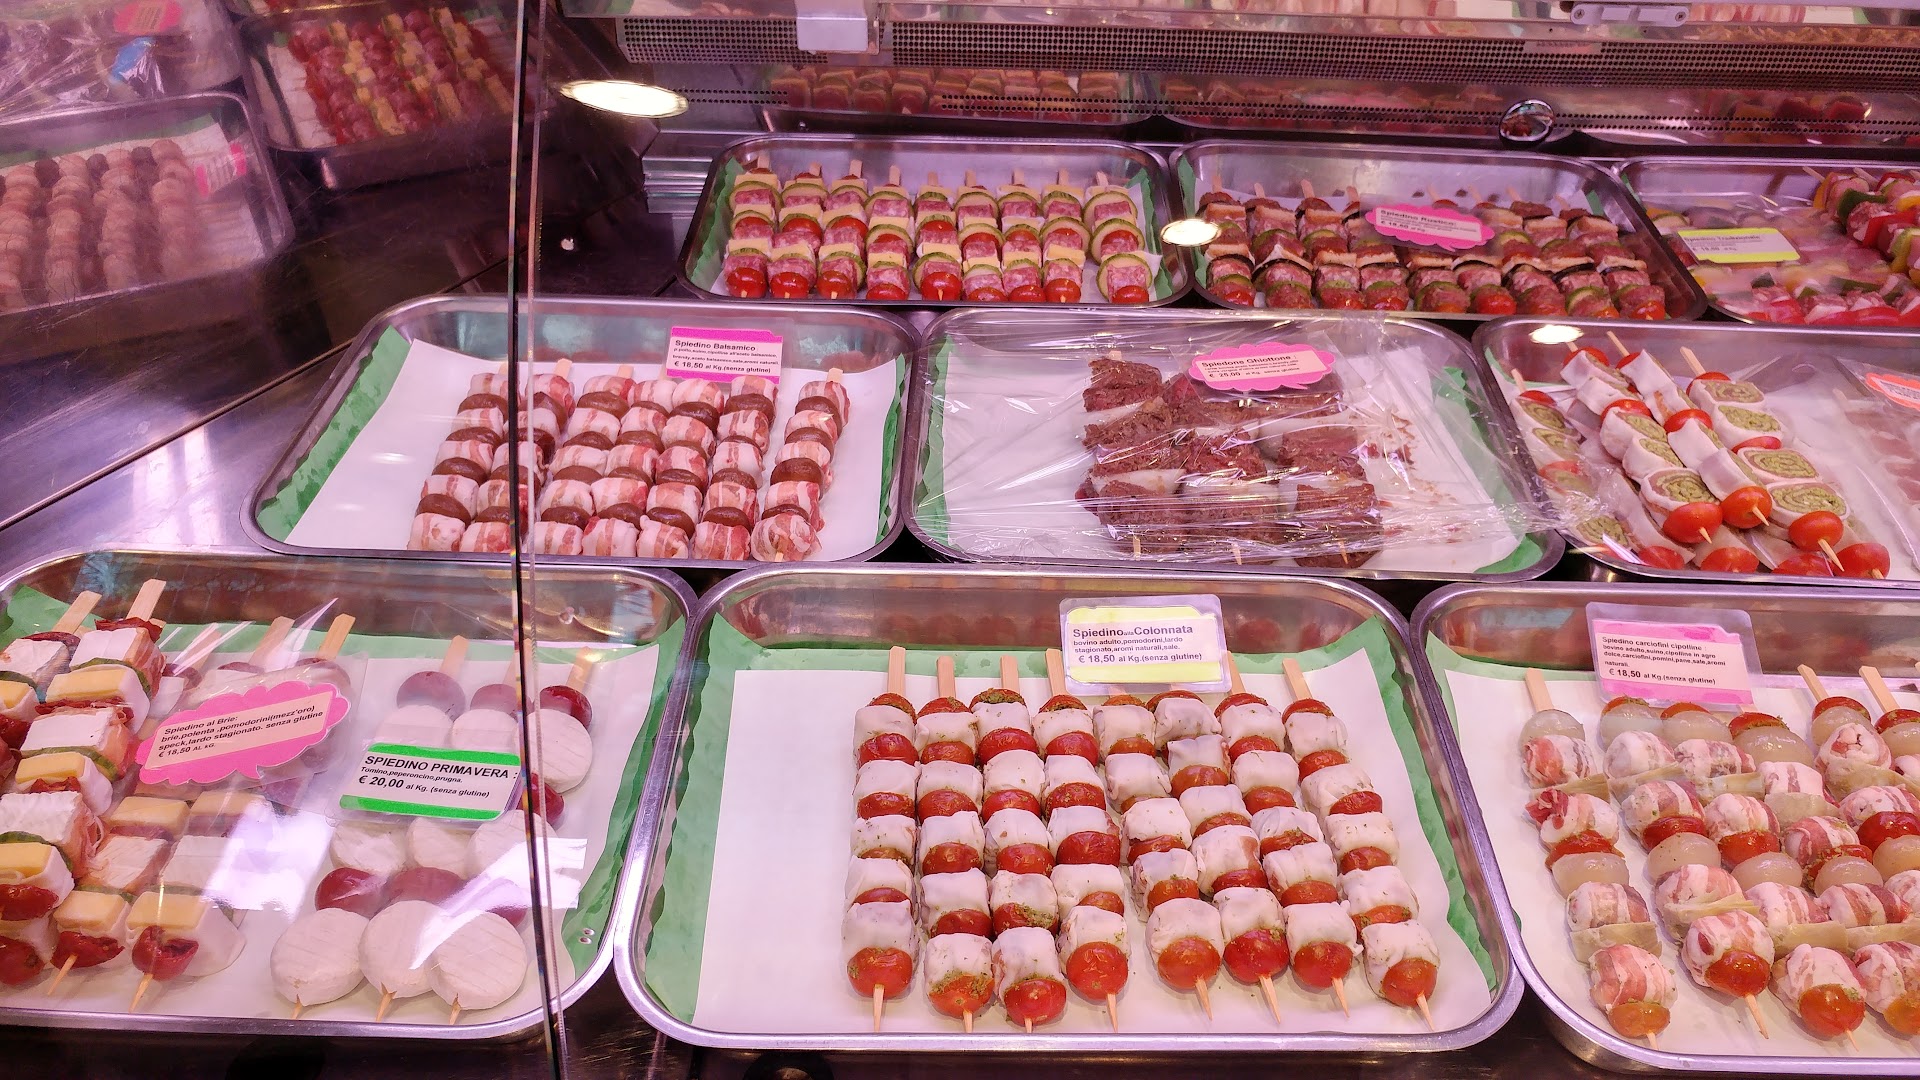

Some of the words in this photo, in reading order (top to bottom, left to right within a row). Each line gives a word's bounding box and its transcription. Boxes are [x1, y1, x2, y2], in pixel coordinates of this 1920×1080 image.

[675, 340, 712, 348] Spiedino
[714, 342, 756, 352] Balsamico
[682, 361, 704, 369] 18,50
[746, 366, 770, 374] glutine)
[1073, 628, 1124, 640] Spiedino
[1134, 625, 1193, 636] Colonnata
[1135, 644, 1180, 652] naturali,sale.
[1602, 636, 1634, 645] Spiedino
[1636, 640, 1670, 648] carciofini
[1078, 655, 1086, 663] €
[1088, 654, 1116, 664] 18,50
[1170, 653, 1202, 662] glutine)
[1609, 668, 1614, 676] €
[1617, 669, 1641, 678] 18,50
[1688, 677, 1716, 685] glutine)
[158, 736, 212, 751] speck,lardo
[265, 718, 291, 729] senza
[293, 711, 324, 724] glutine
[164, 723, 204, 735] Spiedino
[217, 716, 238, 725] Brie:
[167, 746, 190, 756] 18,50
[364, 756, 428, 771] SPIEDINO
[430, 763, 509, 778] PRIMAVERA
[358, 775, 368, 784] €
[369, 776, 404, 788] 20,00
[415, 784, 428, 793] Kg.
[430, 786, 457, 795] (senza
[458, 788, 490, 798] glutine)
